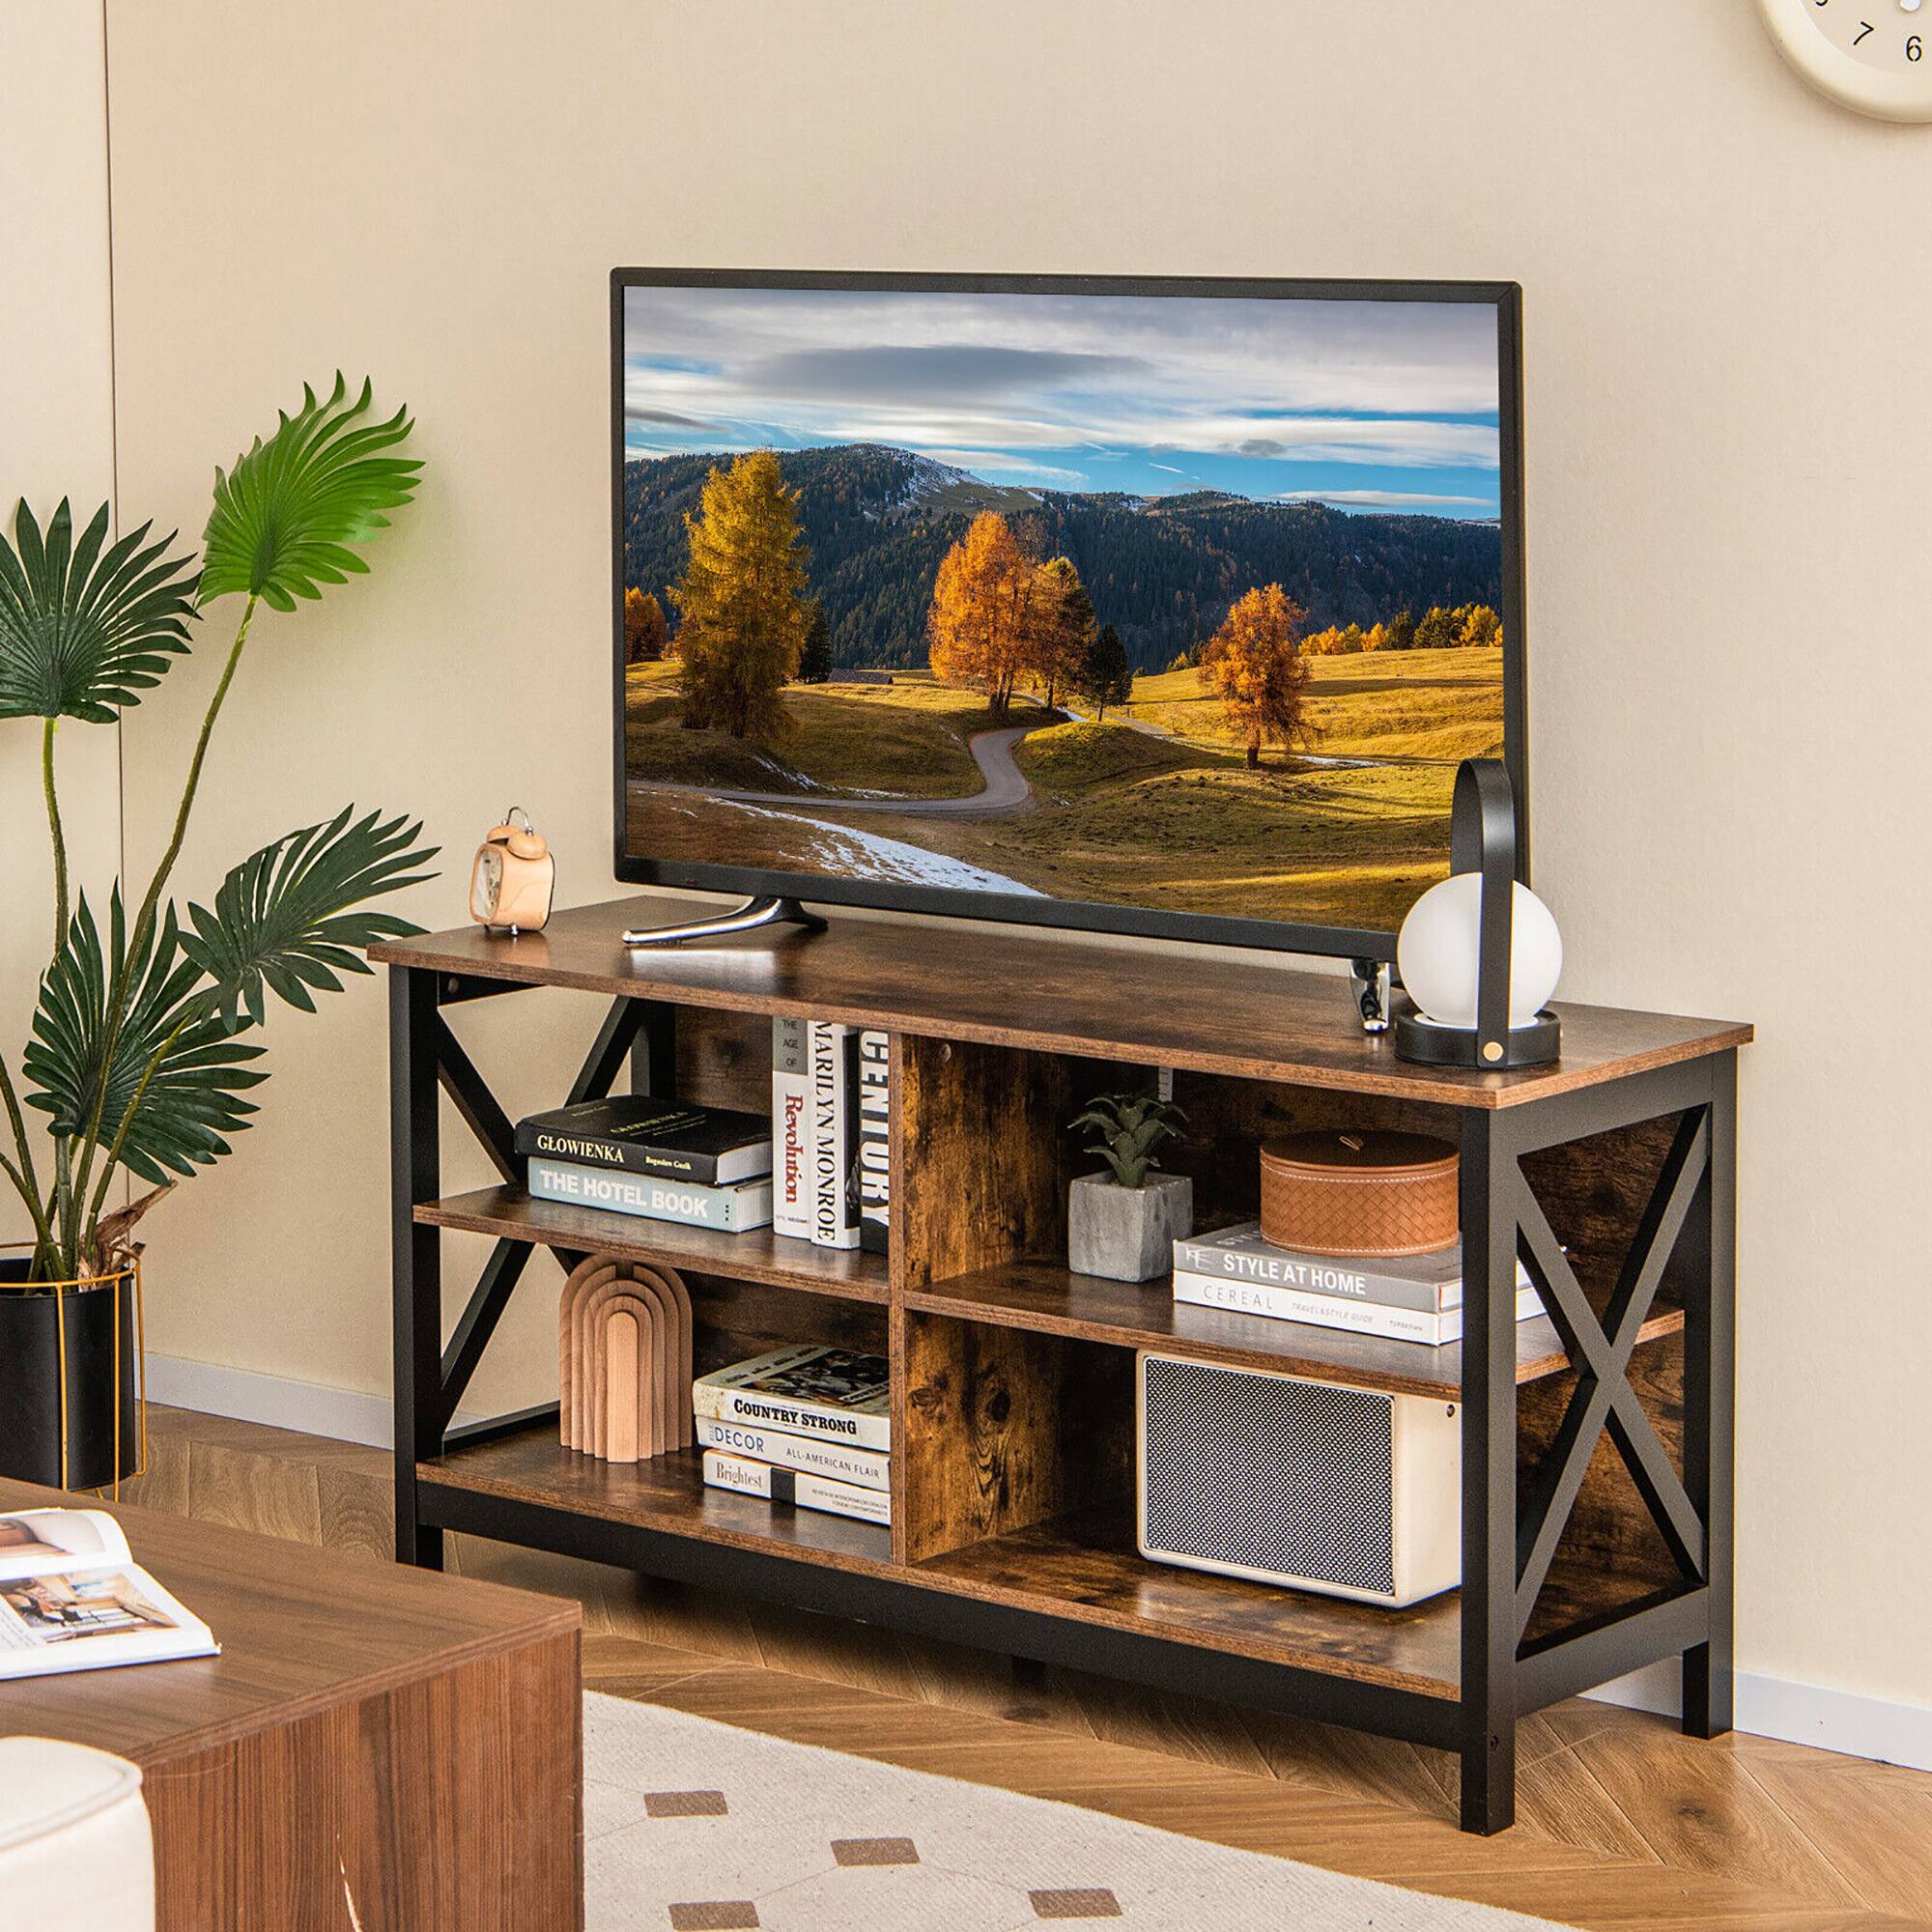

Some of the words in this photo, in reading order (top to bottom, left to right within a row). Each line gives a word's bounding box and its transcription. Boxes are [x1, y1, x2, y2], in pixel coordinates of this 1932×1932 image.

[1853, 20, 1874, 45] 7
[1906, 36, 1922, 62] 6
[814, 1022, 835, 1130] MARILYN
[785, 1094, 804, 1204] Revolution
[540, 1170, 579, 1194] THE
[583, 1177, 647, 1207] HOTEL
[651, 1189, 708, 1218] BOOK
[816, 1136, 836, 1240] MONROE
[1223, 1254, 1280, 1280] STYLE
[1283, 1264, 1307, 1285] AT
[1311, 1266, 1366, 1296] HOME
[1204, 1285, 1273, 1310] CEREAL
[734, 1399, 799, 1424] COUNTRY
[801, 1413, 857, 1435] STRONG
[715, 1426, 764, 1452] DECOR
[786, 1448, 851, 1471] ALL-AMERICAN
[855, 1464, 879, 1479] FLAIR
[717, 1462, 762, 1488] Brightest
